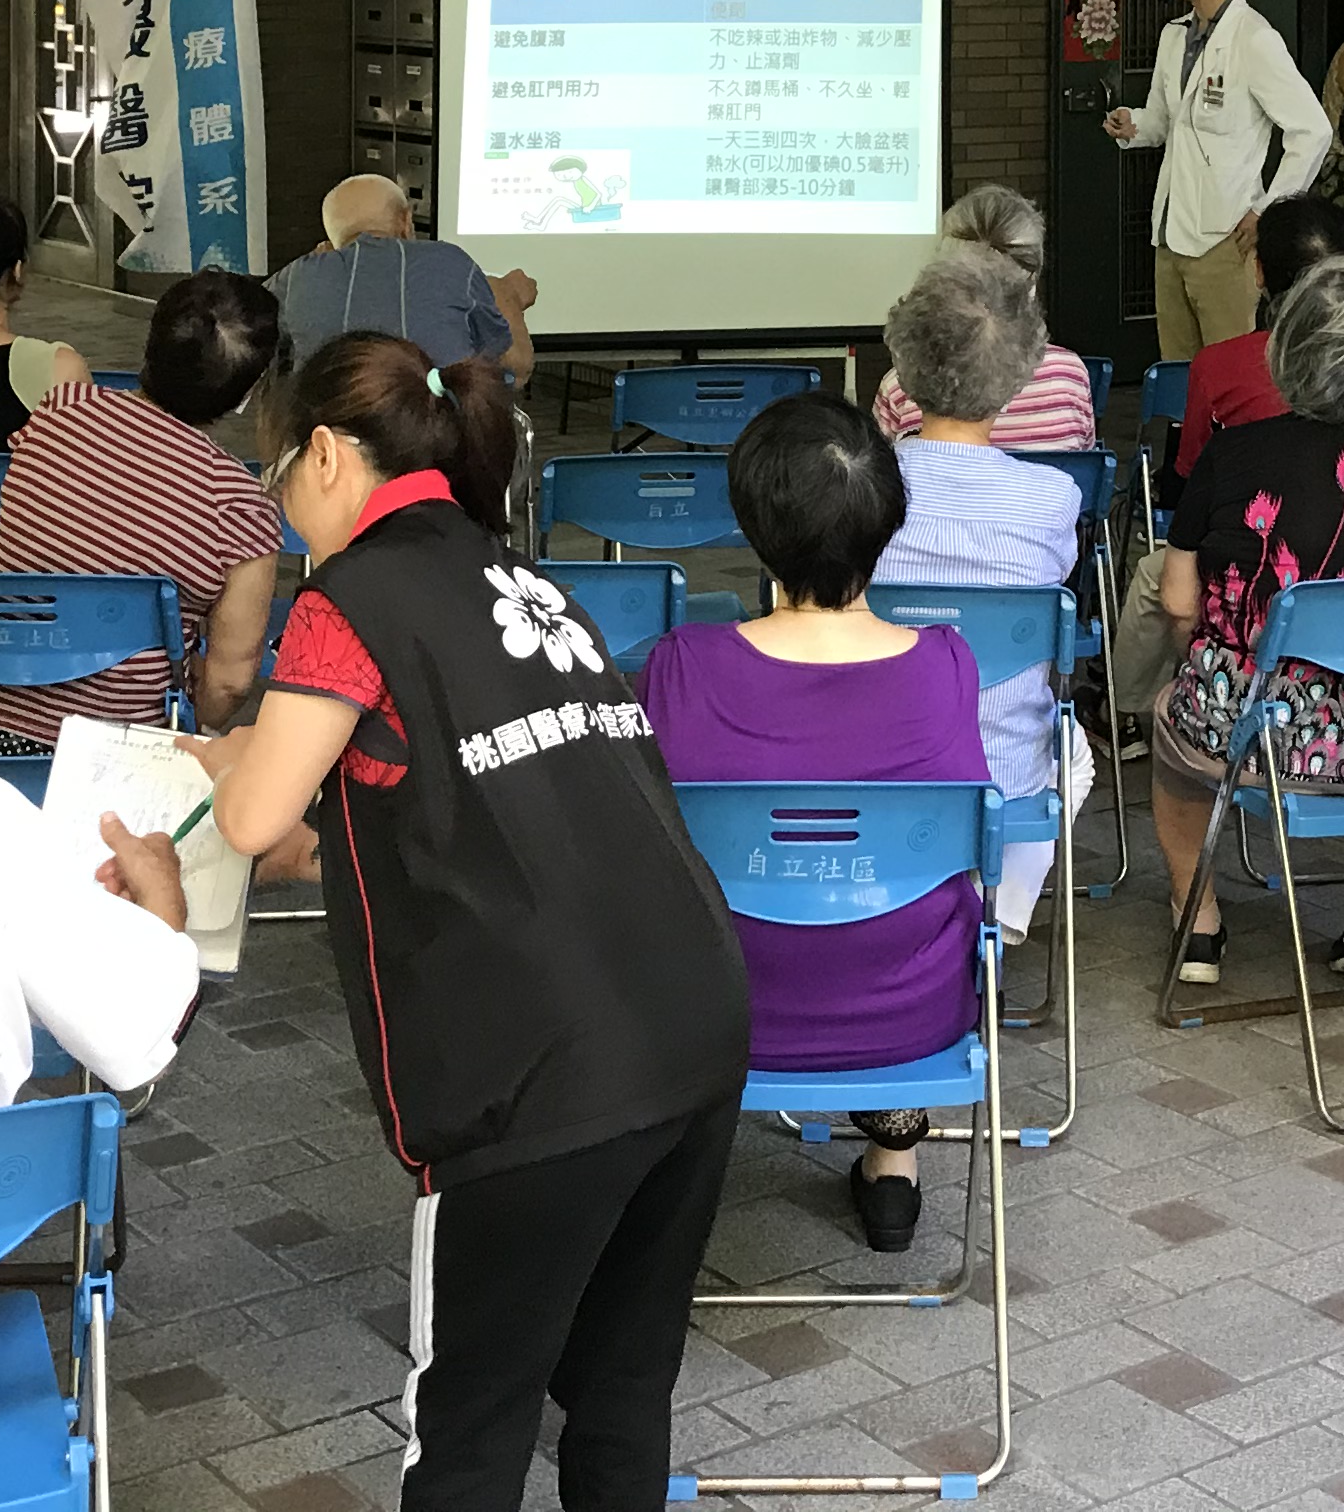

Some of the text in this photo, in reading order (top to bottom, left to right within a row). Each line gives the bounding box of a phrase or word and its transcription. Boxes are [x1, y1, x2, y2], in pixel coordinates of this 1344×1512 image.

[493, 29, 566, 48] 避免腹瀉
[709, 28, 912, 48] 不吃辣或油炸物、減少壓
[709, 52, 800, 71] 力、止瀉劑
[492, 80, 600, 99] 避免肛門用力
[707, 79, 911, 99] 不久蹲馬桶、不久坐、輕
[707, 103, 762, 121] 擦肛門
[490, 131, 562, 150] 溫水坐浴
[705, 178, 856, 197] 讓臀部浸5-10分鐘
[649, 500, 690, 519] 自立
[747, 847, 877, 883] 自立社區
